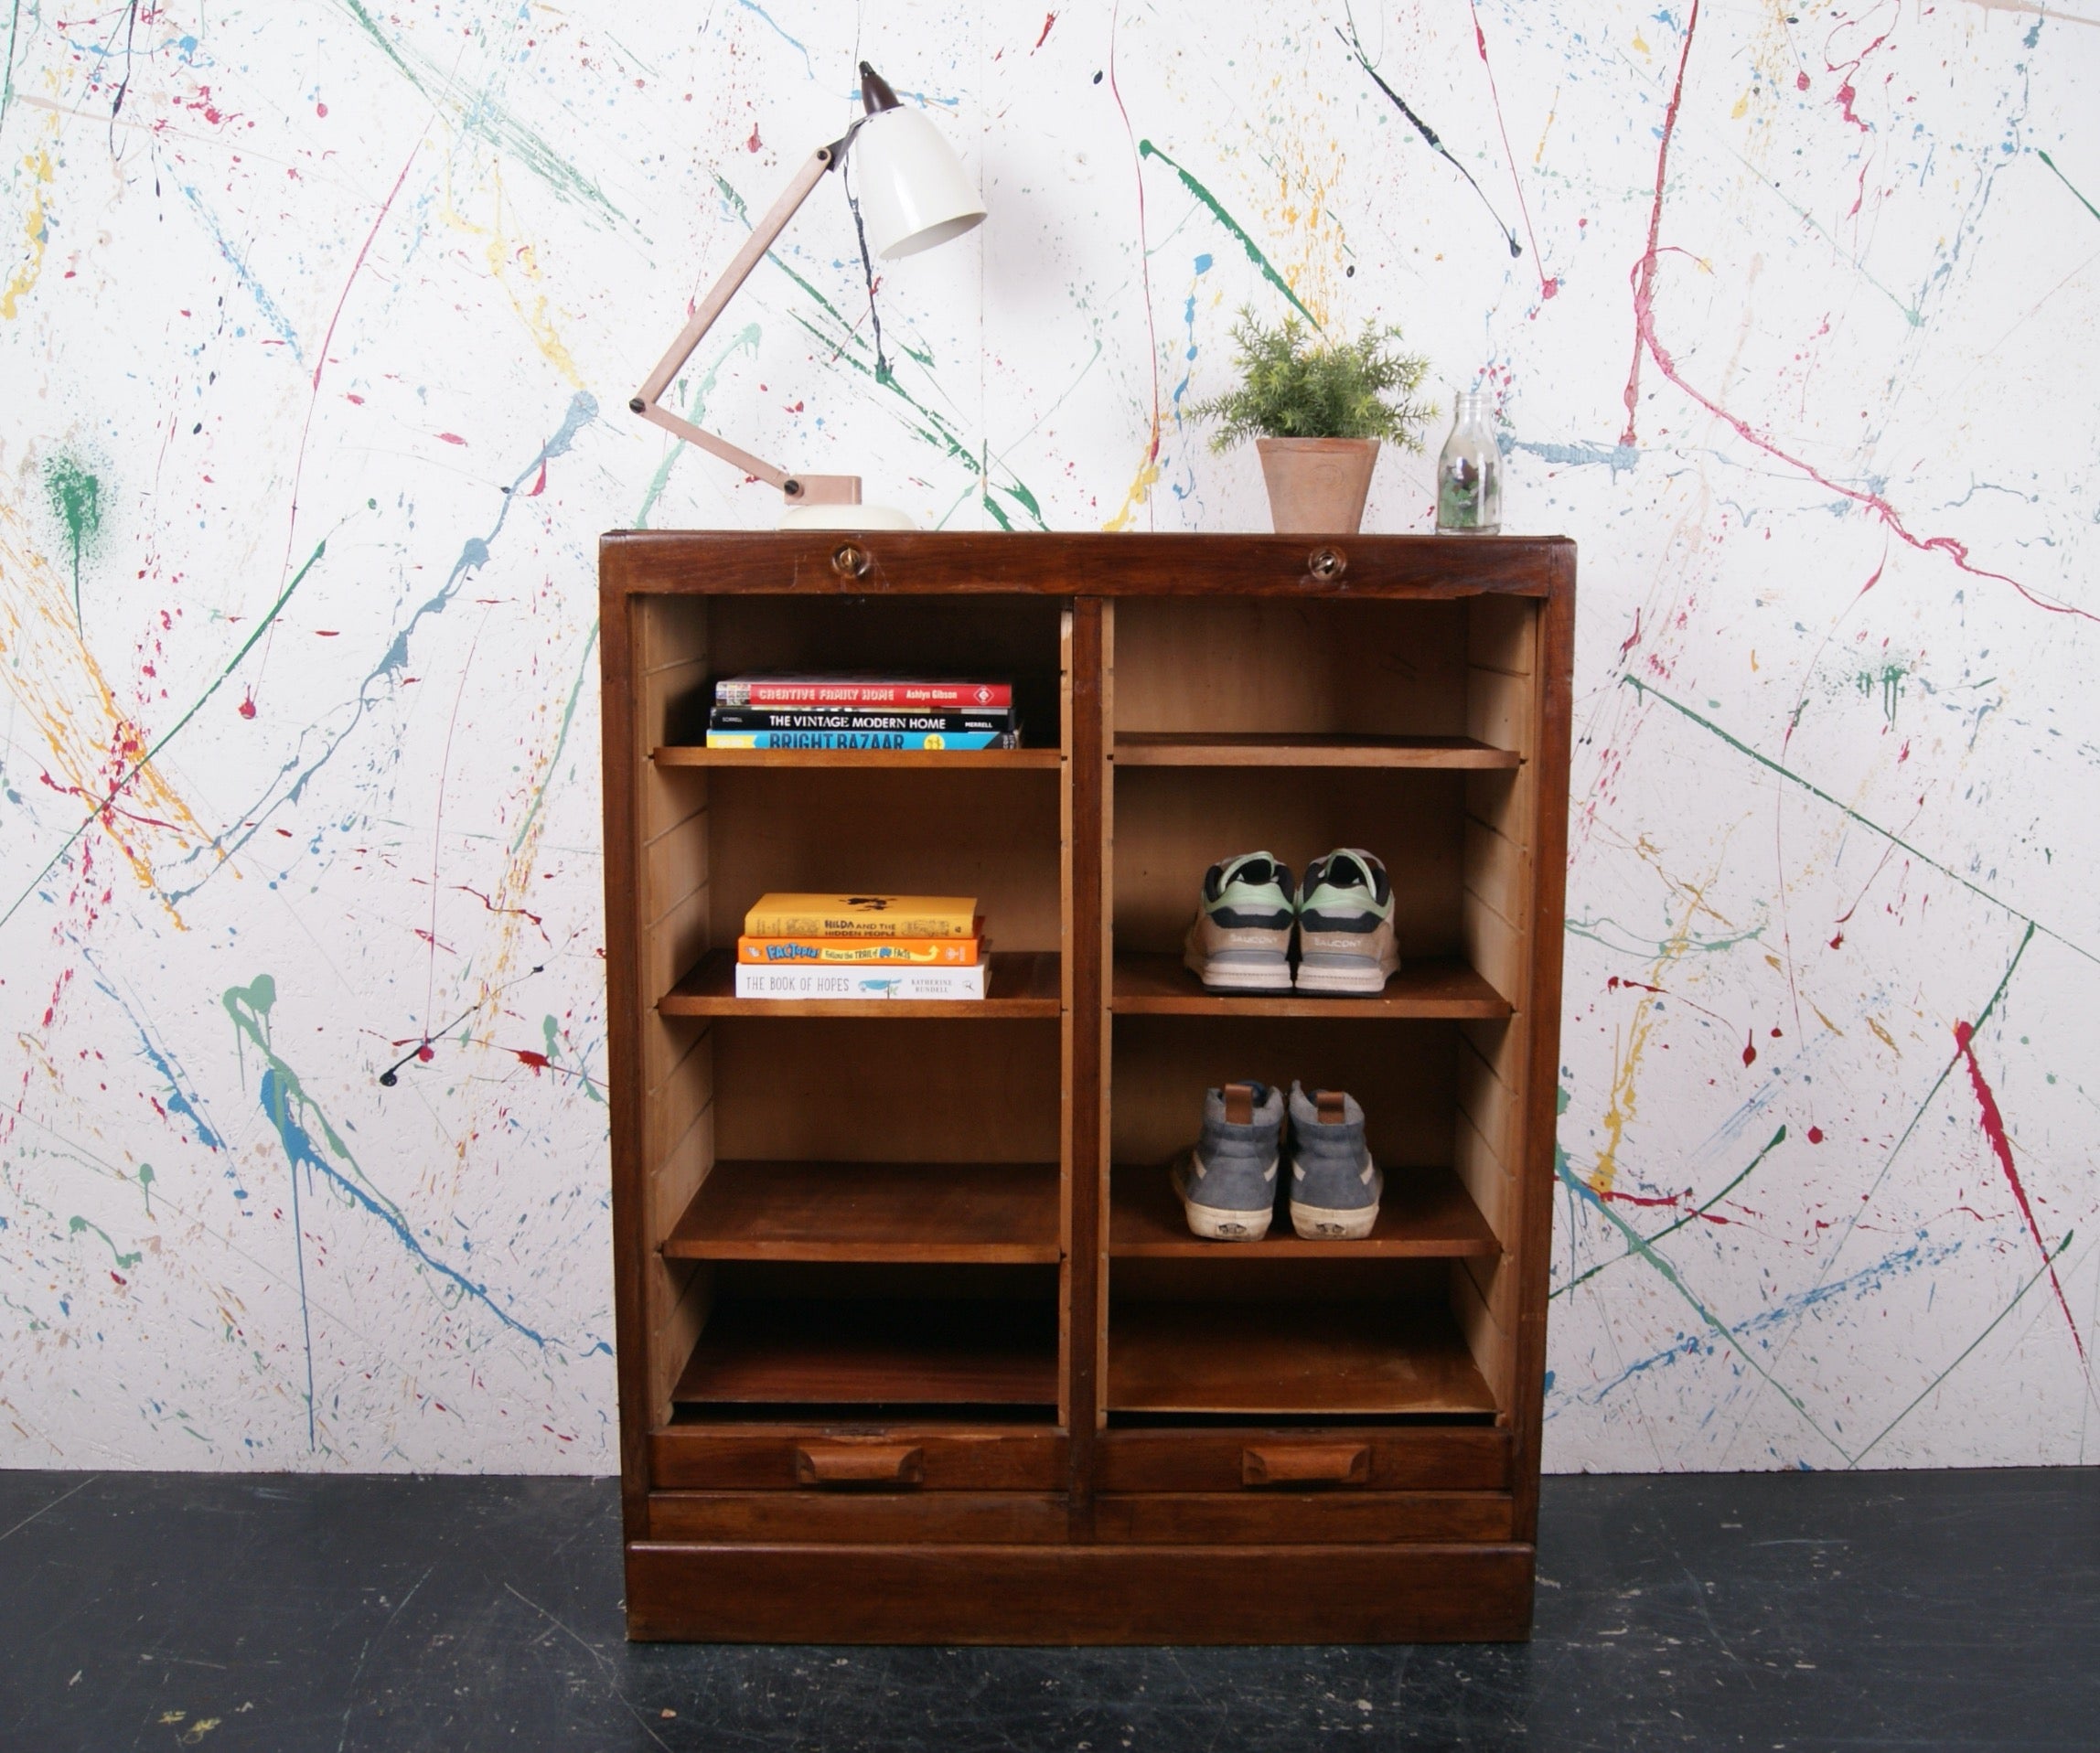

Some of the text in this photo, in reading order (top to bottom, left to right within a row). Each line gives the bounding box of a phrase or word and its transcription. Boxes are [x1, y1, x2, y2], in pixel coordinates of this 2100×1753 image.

[759, 689, 895, 700] CREATIVE FAMILY HOME
[905, 689, 958, 701] Ashlyn Gibson
[769, 715, 946, 730] THE VINTAGE MODERN HOME
[769, 733, 905, 749] BRIGHT BAZAAR
[825, 920, 855, 930] HILDA
[746, 977, 850, 992] THE BOOK OF HOPES
